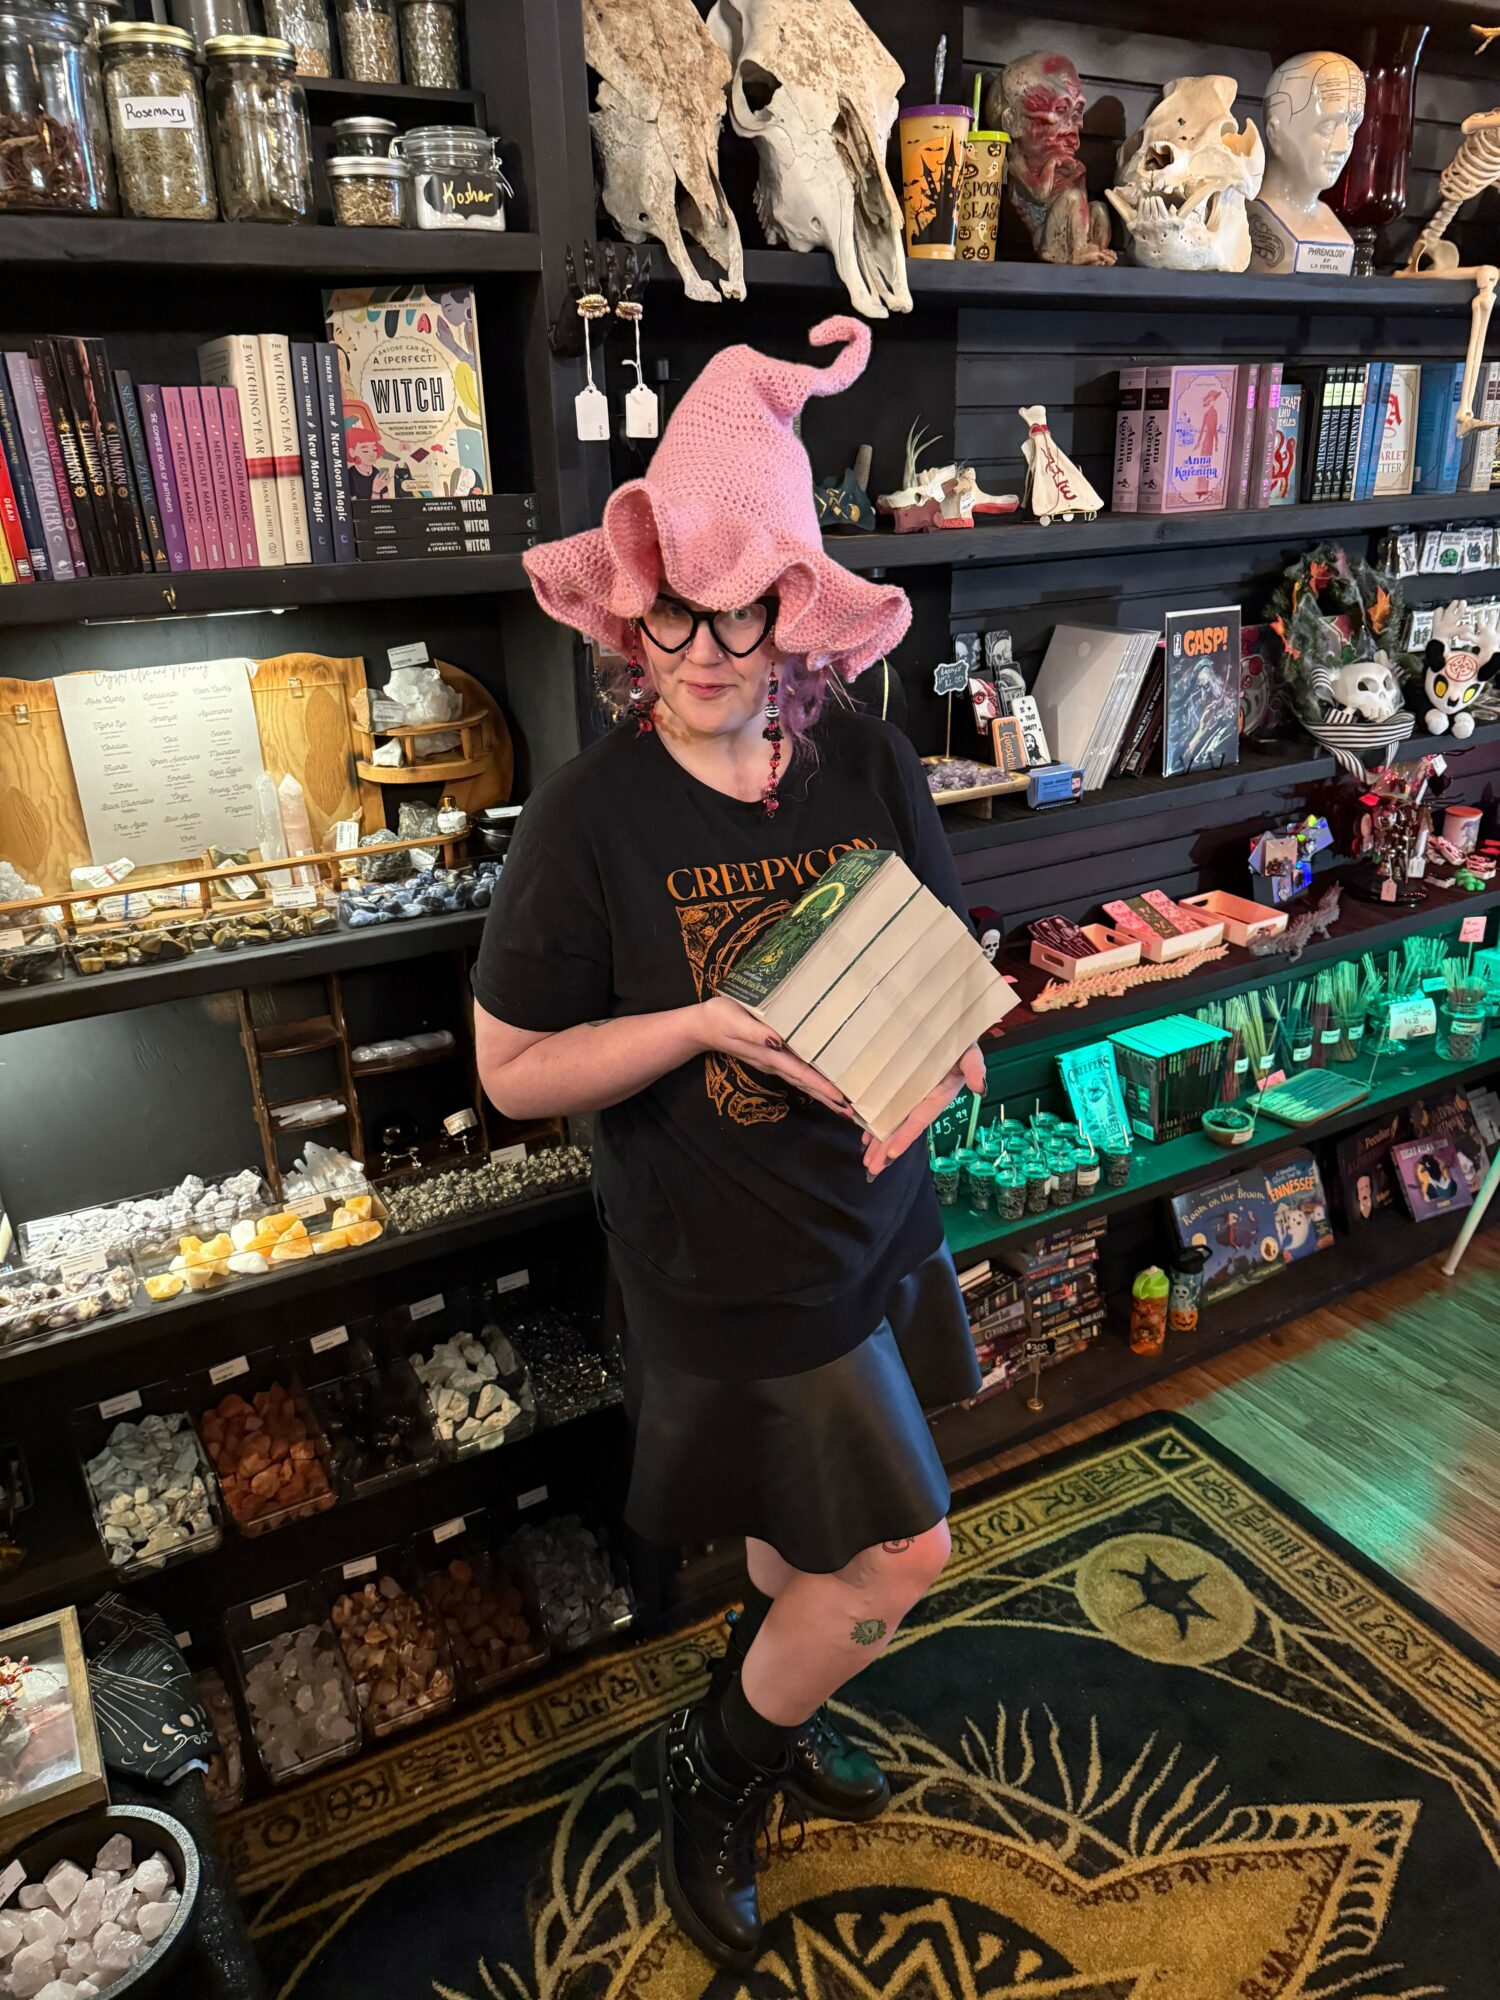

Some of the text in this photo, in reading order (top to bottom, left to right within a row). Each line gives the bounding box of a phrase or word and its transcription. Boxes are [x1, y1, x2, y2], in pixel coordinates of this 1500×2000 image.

[125, 103, 186, 123] Rosemary
[442, 180, 494, 209] Kosher
[1308, 248, 1345, 258] PHRENOLOGY
[373, 354, 437, 364] A (PERFECT)
[378, 345, 402, 356] ANYONE
[121, 385, 140, 443] SEASONS
[245, 353, 265, 454] WITCHING YEAR
[273, 352, 293, 452] WITCHING YEAR
[370, 377, 445, 414] WITCH
[38, 398, 73, 513] FOLKLORE MAGICK
[80, 432, 104, 483] LUMINARY
[1125, 426, 1136, 462] Anna
[1152, 425, 1163, 462] Anna
[1316, 409, 1330, 471] FRANKENSTEIN
[1325, 409, 1340, 470] FRANKENSTEIN
[1335, 408, 1350, 470] FRANKENSTEIN
[1380, 451, 1407, 460] ARLET
[60, 433, 84, 485] LUMINARY
[106, 434, 128, 485] LUMINARY
[331, 433, 346, 522] New Moon Magic
[1175, 466, 1218, 480] Karenina
[1184, 456, 1212, 465] Anna
[1378, 463, 1401, 473] ETTER
[30, 449, 63, 533] SCAPEGRACERS
[176, 442, 196, 524] MERCURY MAGIC
[195, 441, 215, 522] MERCURY MAGIC
[213, 440, 232, 521] MERCURY MAGIC
[232, 441, 250, 521] MERCURY MAGIC
[261, 481, 270, 502] DIANA
[289, 479, 298, 500] DIANA
[307, 433, 324, 523] New Moon Magic
[4, 497, 16, 522] DEAN
[461, 499, 487, 512] WITCH
[464, 519, 490, 532] WITCH
[465, 539, 491, 552] WITCH
[1183, 626, 1229, 657] GASP!
[1181, 1188, 1265, 1227] Room on the Broom
[1264, 1176, 1315, 1203] TENNESSEE
